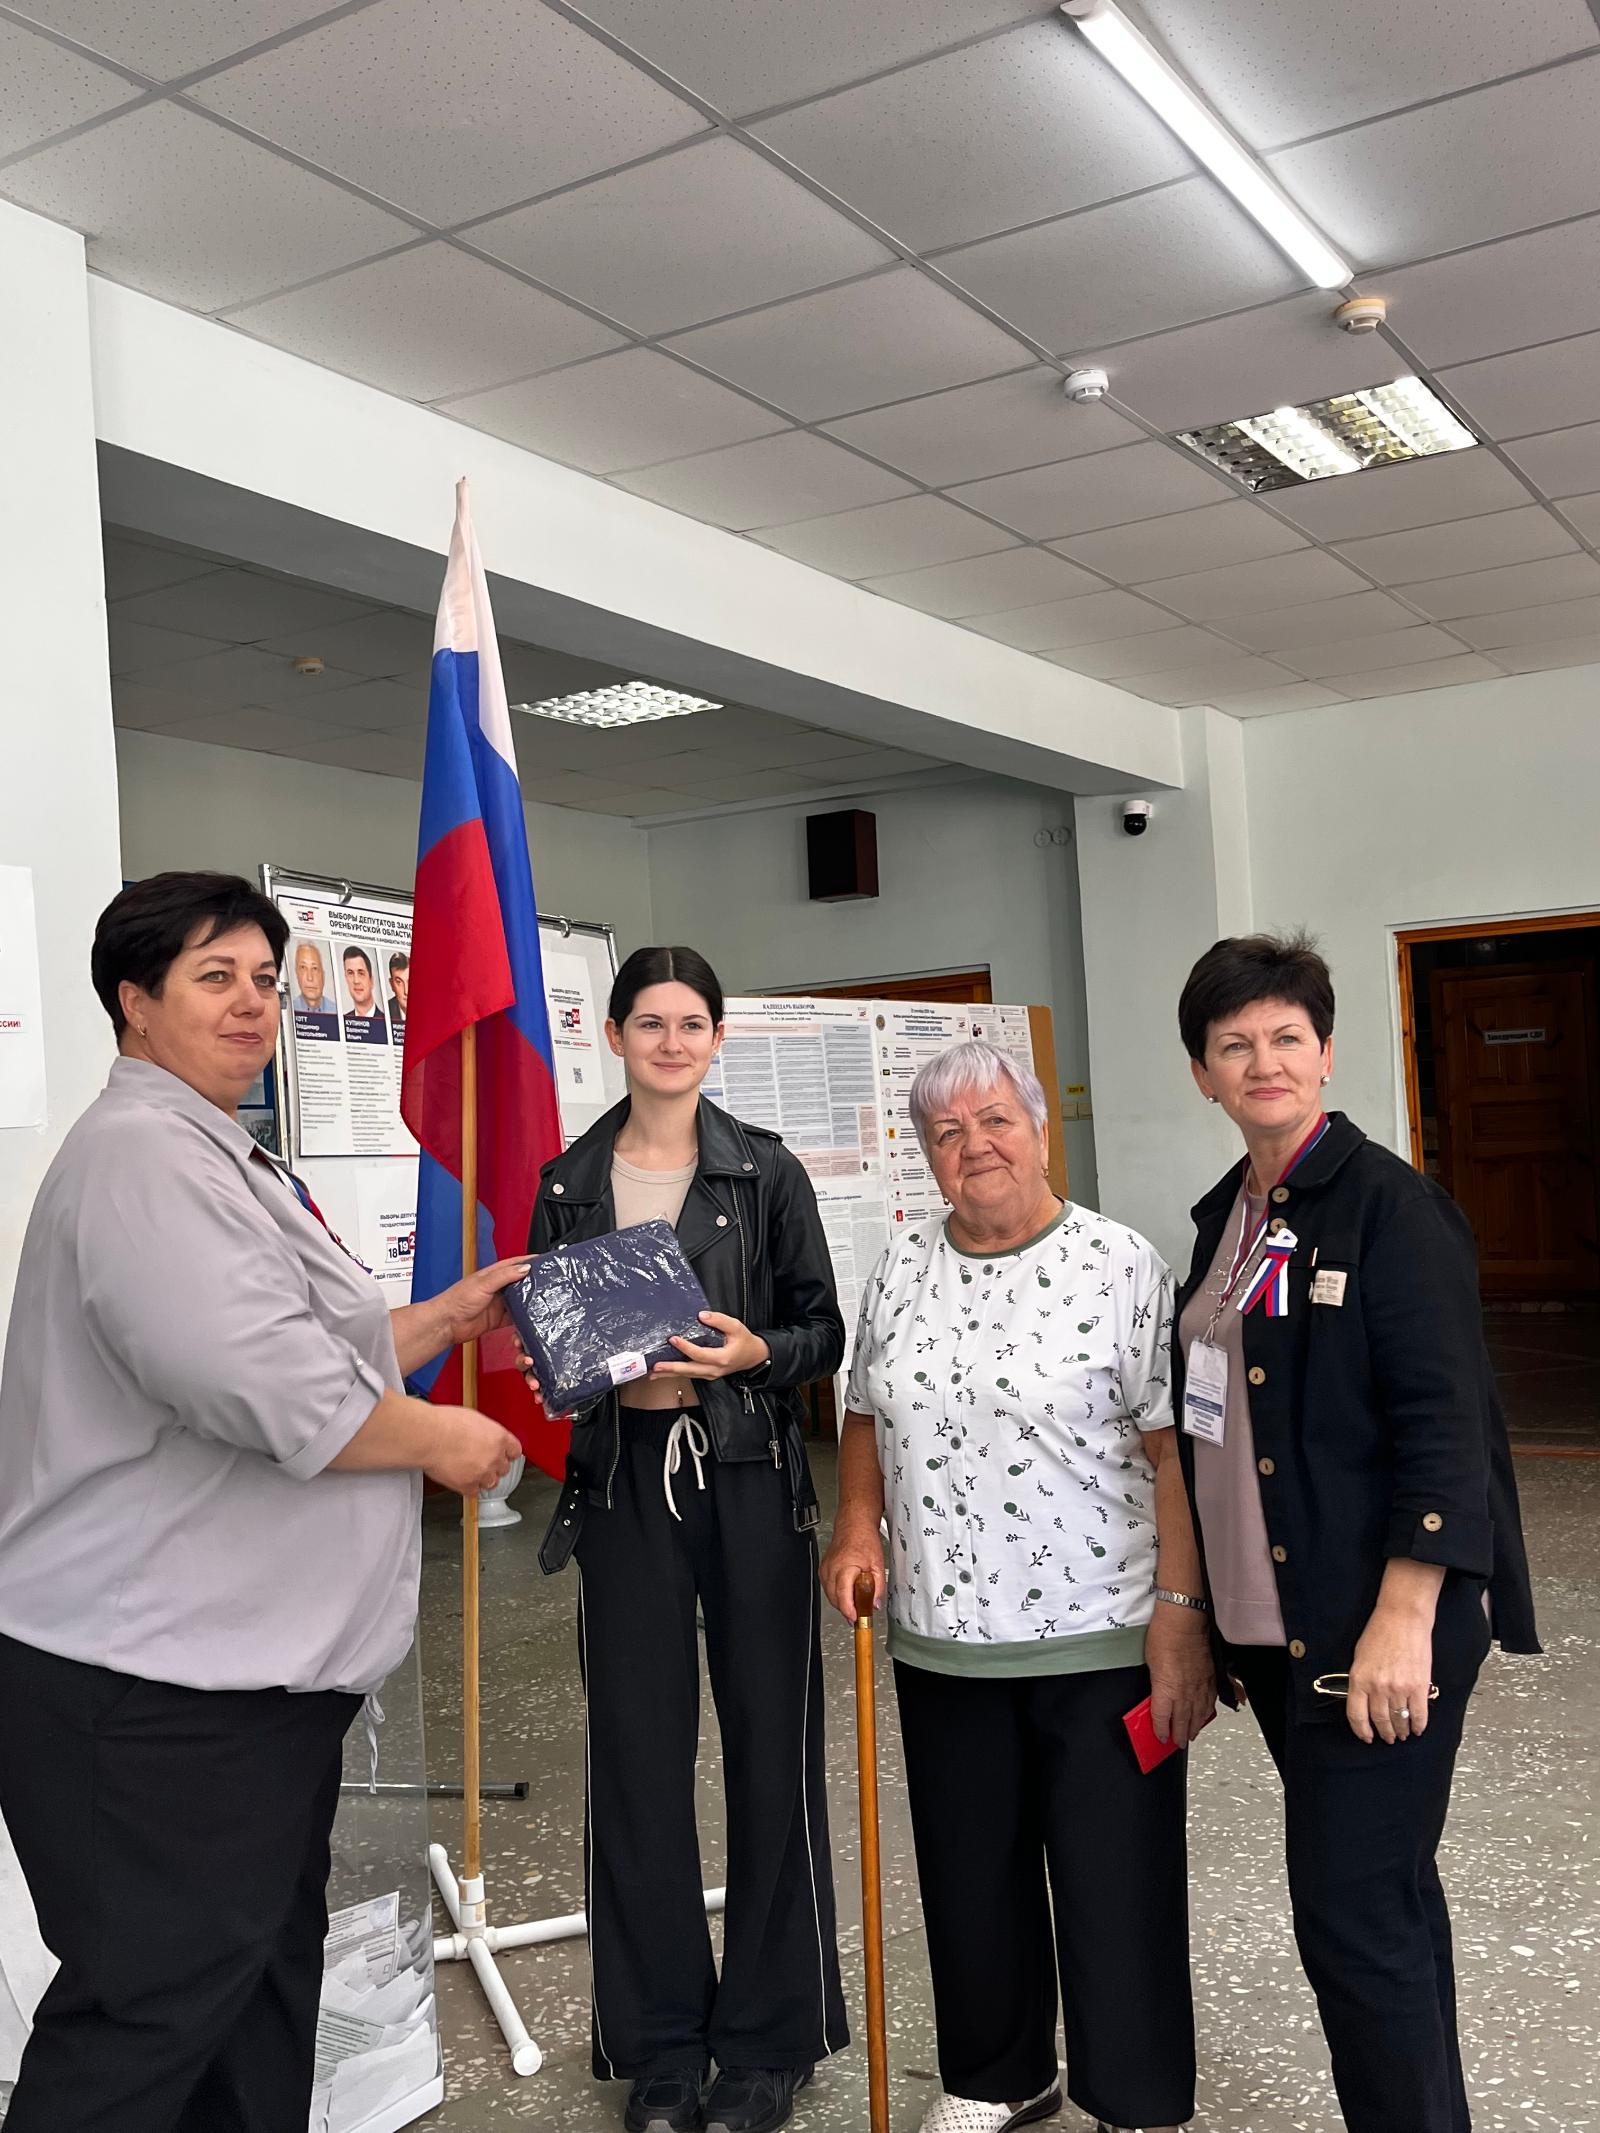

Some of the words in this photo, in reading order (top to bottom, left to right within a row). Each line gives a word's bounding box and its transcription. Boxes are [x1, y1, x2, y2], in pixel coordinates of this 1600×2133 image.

[328, 911, 358, 922] ВЫБОРЫ
[359, 915, 396, 928] ДЕПУТАТОВ
[329, 920, 381, 935] ОРЕНБУРГСКОЙ
[382, 928, 412, 939] ОБЛАСТИ
[0, 1020, 21, 1028] СИИ!
[388, 1247, 398, 1258] 18
[398, 1241, 409, 1252] 19
